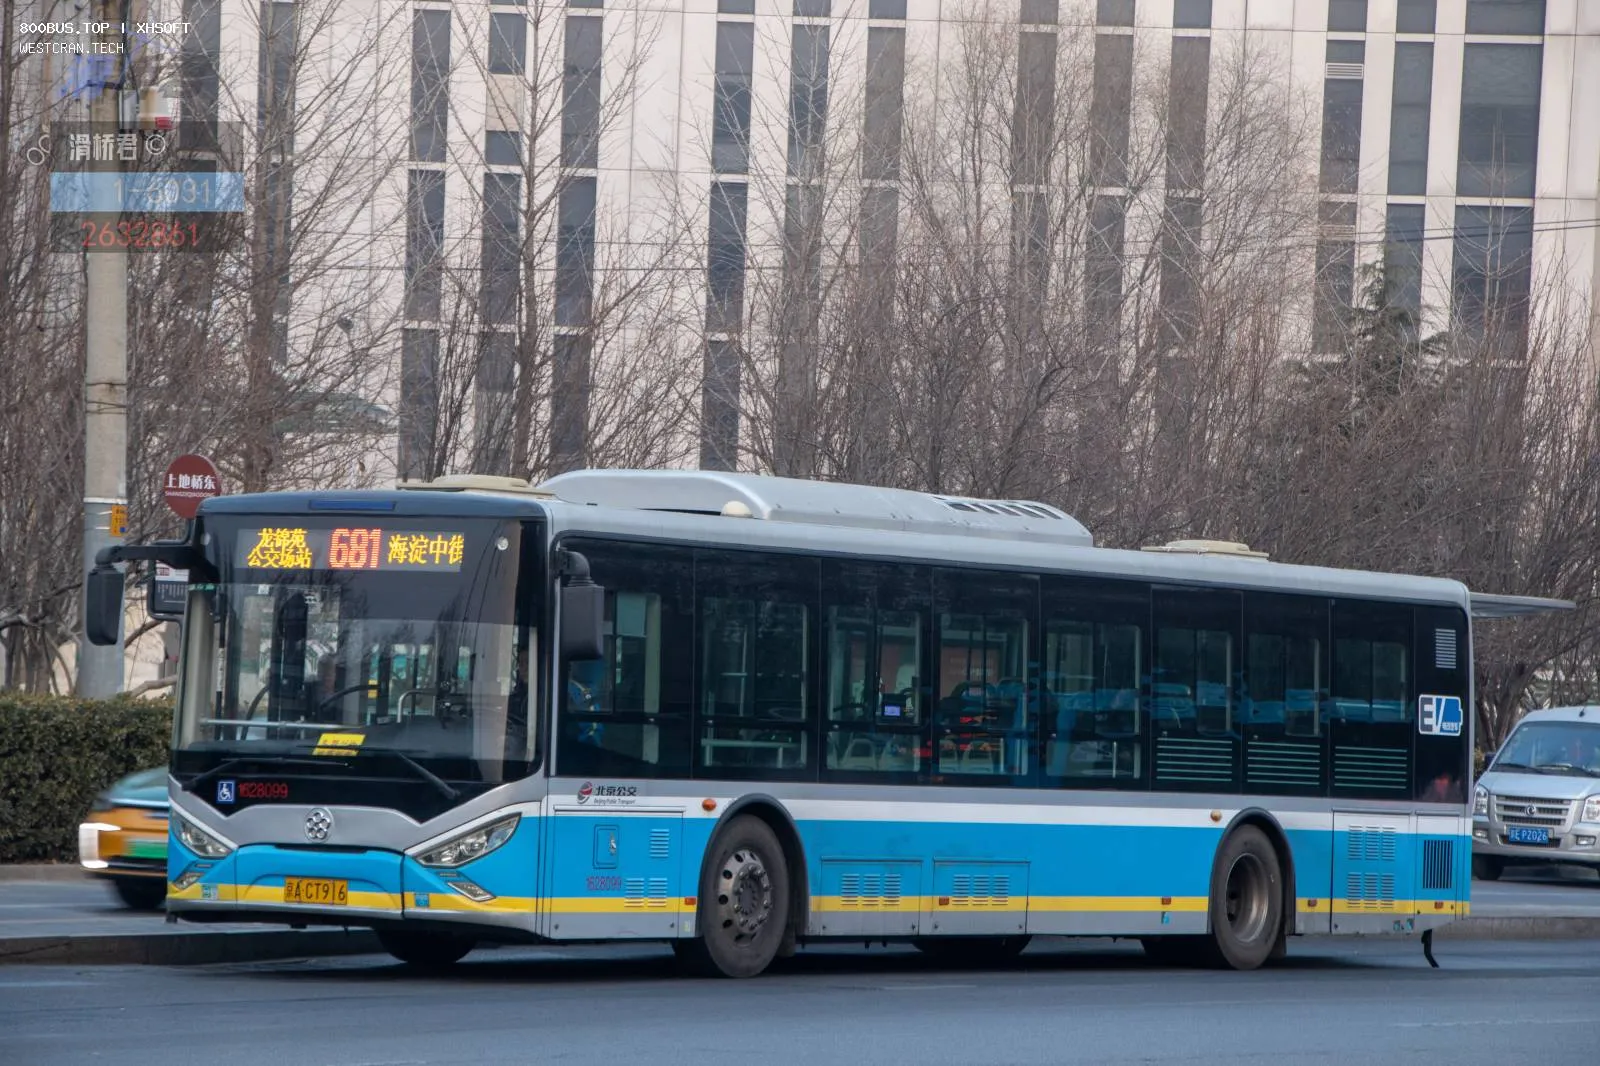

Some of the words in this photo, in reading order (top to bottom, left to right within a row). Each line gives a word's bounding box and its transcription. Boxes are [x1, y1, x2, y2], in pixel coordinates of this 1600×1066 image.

[165, 473, 216, 489] 上地桥东
[329, 528, 382, 569] 681
[247, 546, 313, 569] 公交场站
[238, 782, 289, 798] 1628099
[595, 785, 637, 797] 北京公交
